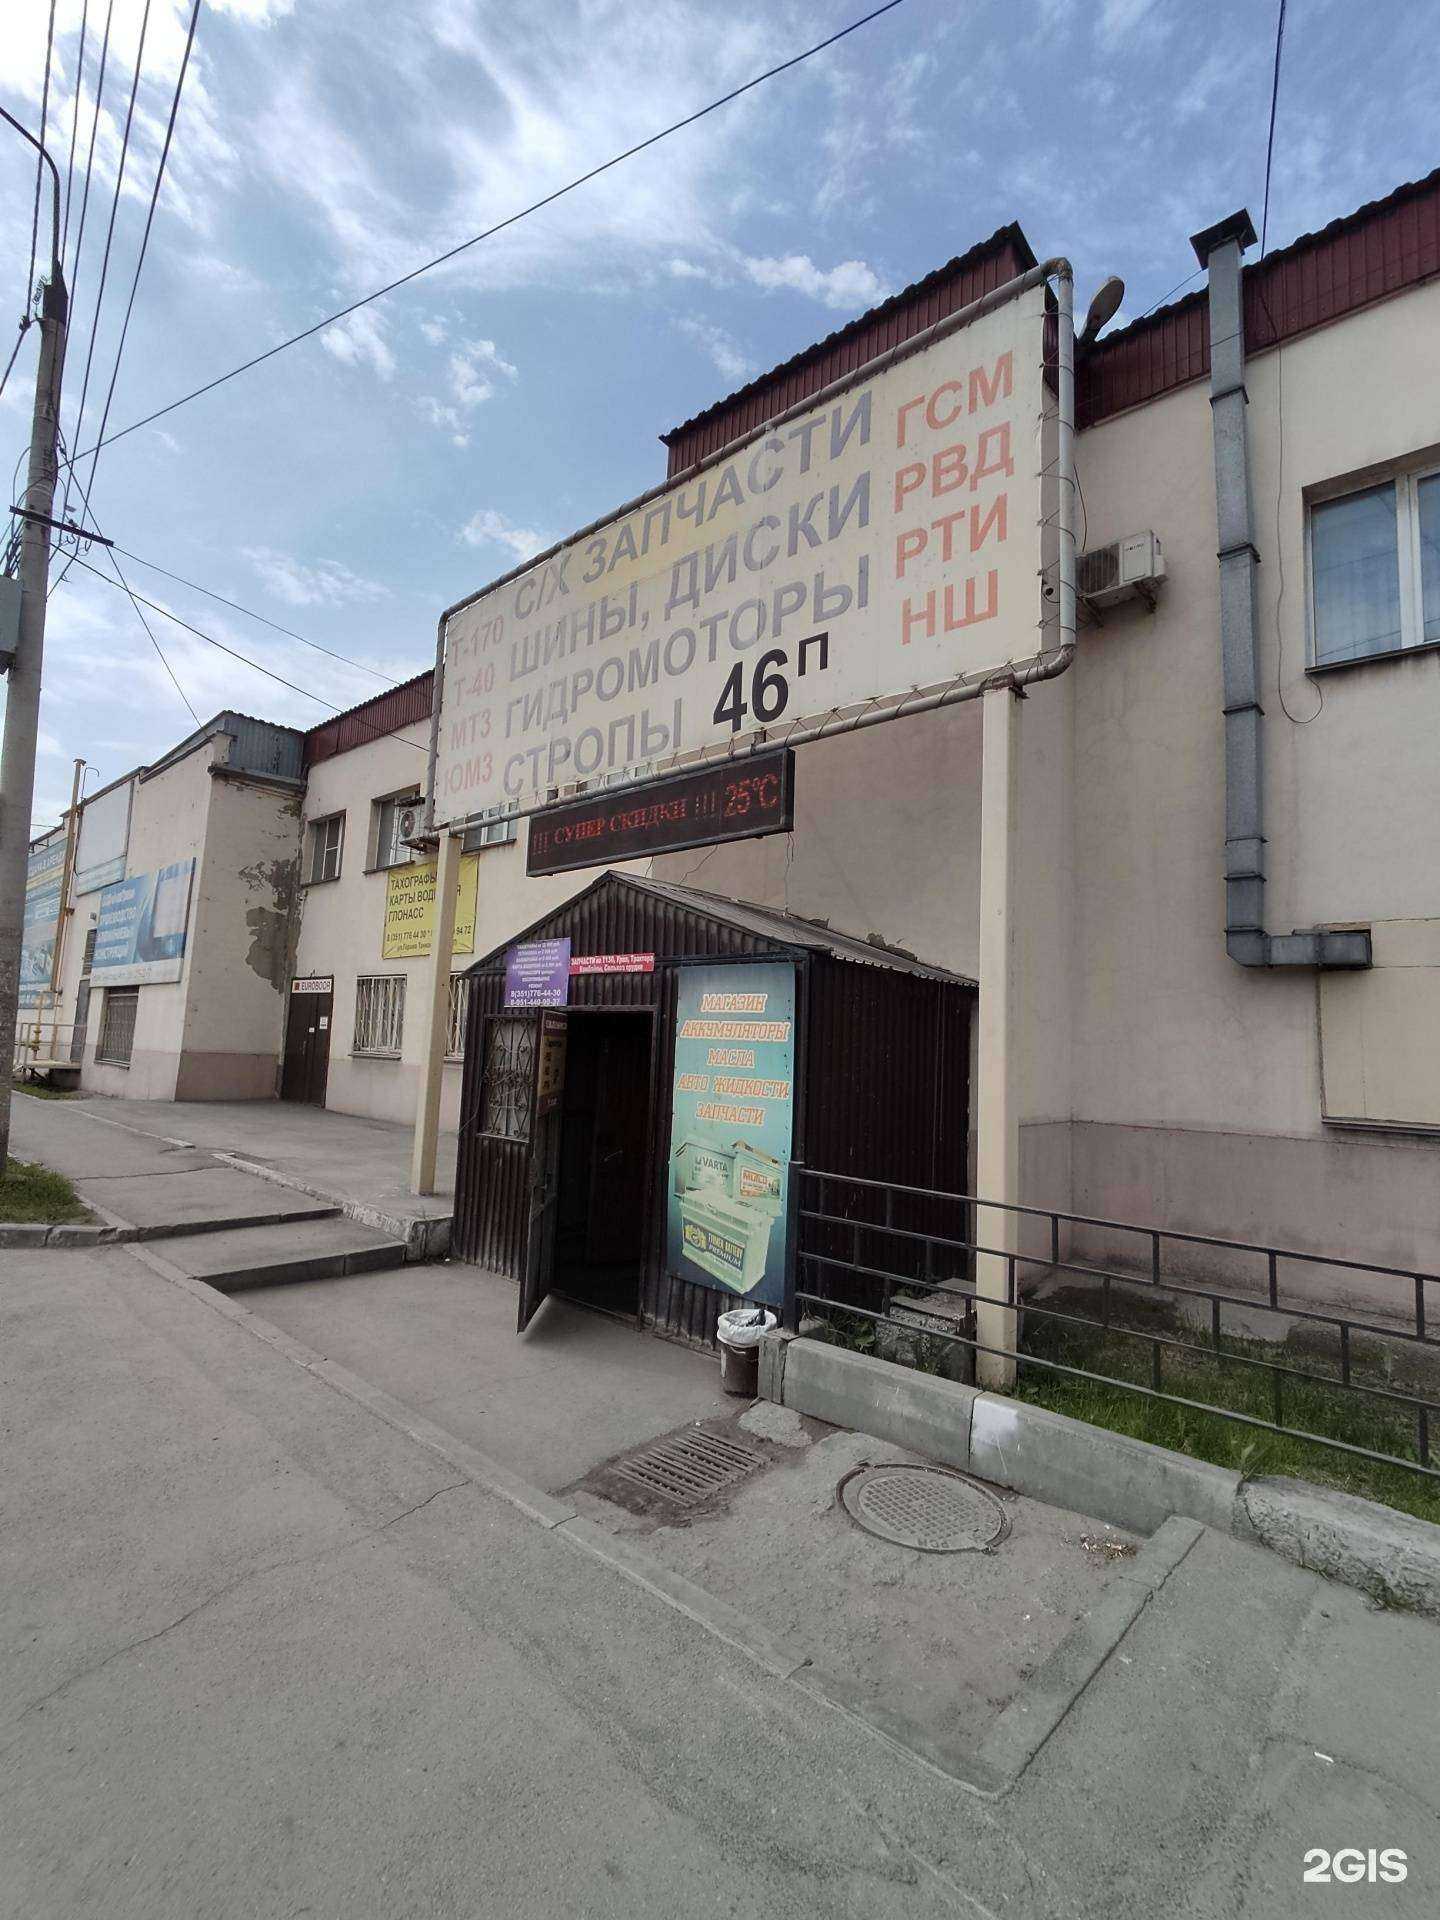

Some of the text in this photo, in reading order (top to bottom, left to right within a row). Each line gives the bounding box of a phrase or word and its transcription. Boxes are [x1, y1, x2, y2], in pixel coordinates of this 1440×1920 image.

[897, 350, 1014, 448] ГСМ
[894, 420, 1015, 513] РВД
[514, 389, 872, 621] С/Х ЗАПЧАСТИ
[896, 492, 1008, 579] РТИ
[509, 471, 870, 682] ШИНЫ, ДИСКИ
[902, 568, 998, 645] НШ
[452, 614, 504, 668] Т-170
[505, 554, 869, 739] ГИДРОМОТОРЫ
[453, 662, 496, 707] Т-40
[451, 708, 493, 750] МТЗ
[503, 697, 683, 796] СТРОПЫ
[554, 817, 606, 845] СУПЕР
[609, 798, 688, 831] СКИДКИ
[388, 907, 424, 922] ГЛОНАСС
[389, 893, 415, 906] КАРТЫ
[701, 993, 768, 1014] МАГАЗИН
[680, 1020, 791, 1042] АККУМУЛЯТОРЫ
[707, 1048, 755, 1069] МАСЛА
[679, 1073, 790, 1100] АВТО ЖИДКОСТИ
[696, 1102, 767, 1127] ЗАПЧАСТИ
[702, 1157, 728, 1172] VARTA
